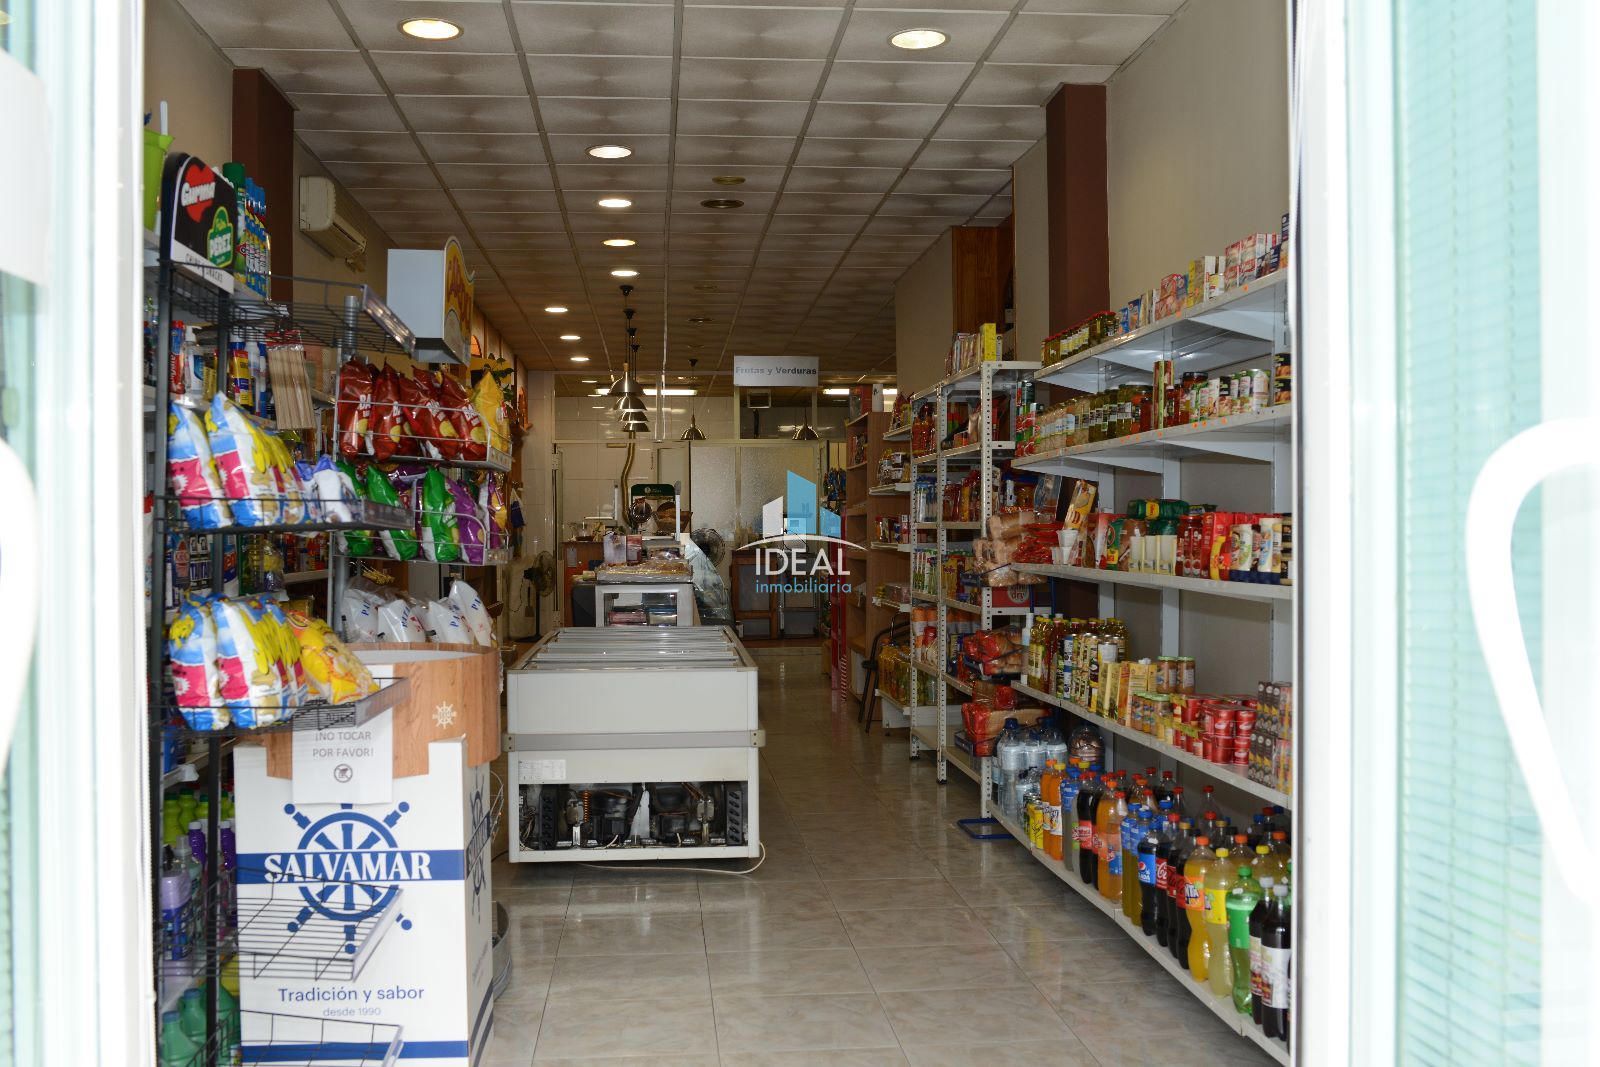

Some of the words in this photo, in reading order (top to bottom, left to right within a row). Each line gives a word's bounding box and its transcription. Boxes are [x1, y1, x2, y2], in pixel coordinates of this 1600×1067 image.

[735, 366, 764, 374] Frutas
[766, 368, 773, 376] y
[776, 366, 817, 375] Verduras
[337, 731, 372, 741] TOCAR
[312, 748, 334, 758] POR
[336, 747, 374, 757] FAVOR!
[263, 851, 433, 884] SALVAMAR
[278, 985, 358, 1003] Tradición
[364, 989, 373, 1004] y
[377, 986, 425, 1001] sabor
[322, 1006, 356, 1017] desde
[358, 1006, 382, 1017] 1990
